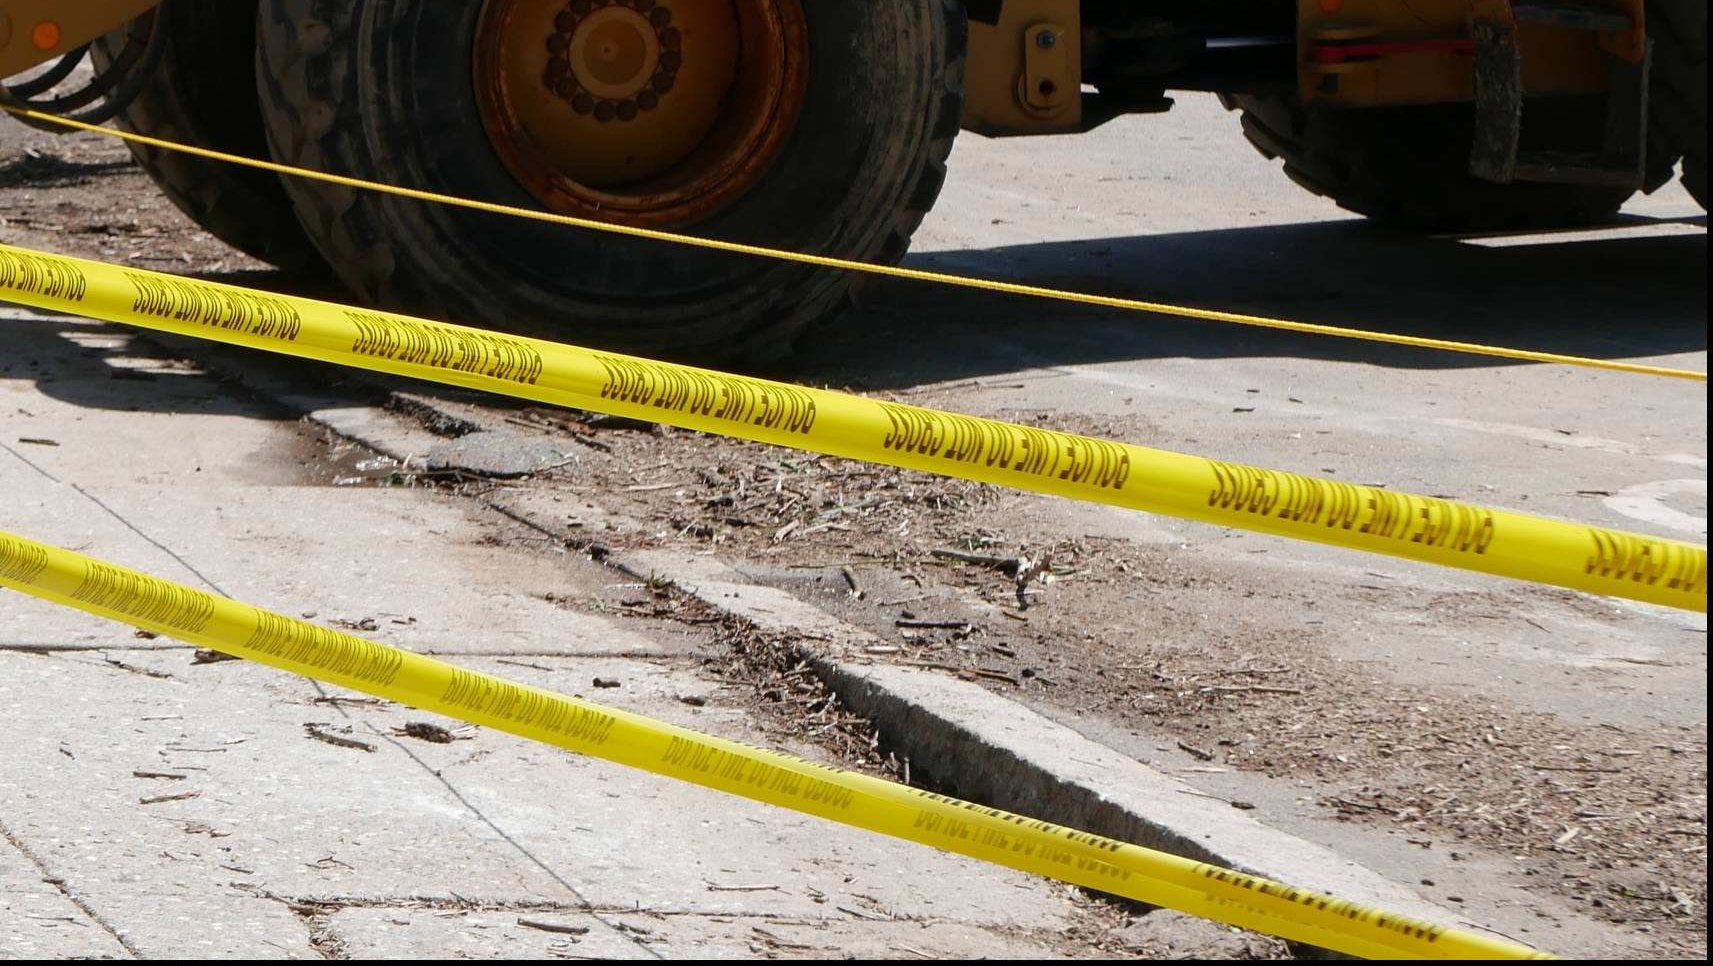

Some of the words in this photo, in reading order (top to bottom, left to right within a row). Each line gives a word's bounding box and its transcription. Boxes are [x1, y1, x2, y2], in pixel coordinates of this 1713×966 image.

[14, 253, 44, 291] LINE
[41, 259, 85, 299] POLICE
[129, 275, 175, 316] CROSS
[170, 282, 202, 322] NOT
[200, 287, 223, 326] DO
[219, 290, 253, 331] LINE
[248, 295, 300, 340] POLICE
[348, 314, 400, 357] CROSS
[395, 321, 430, 362] NOT
[427, 327, 453, 367] DO
[449, 331, 488, 373] LINE
[483, 337, 542, 383] POLICE
[595, 354, 656, 405] CROSS
[651, 365, 689, 410] NOT
[687, 372, 716, 415] DO
[712, 375, 756, 422] LINE
[751, 381, 816, 434] POLICE
[881, 404, 945, 457] CROSS
[943, 414, 985, 463] NOT
[985, 420, 1015, 467] DO
[1013, 425, 1059, 475] LINE
[1058, 433, 1129, 488] POLICE
[1207, 460, 1280, 518] CROSS
[1277, 473, 1325, 524] NOT
[1326, 482, 1360, 530] DO
[1358, 486, 1412, 540] LINE
[1410, 498, 1494, 557] POLICE
[1584, 529, 1667, 587] CROSS
